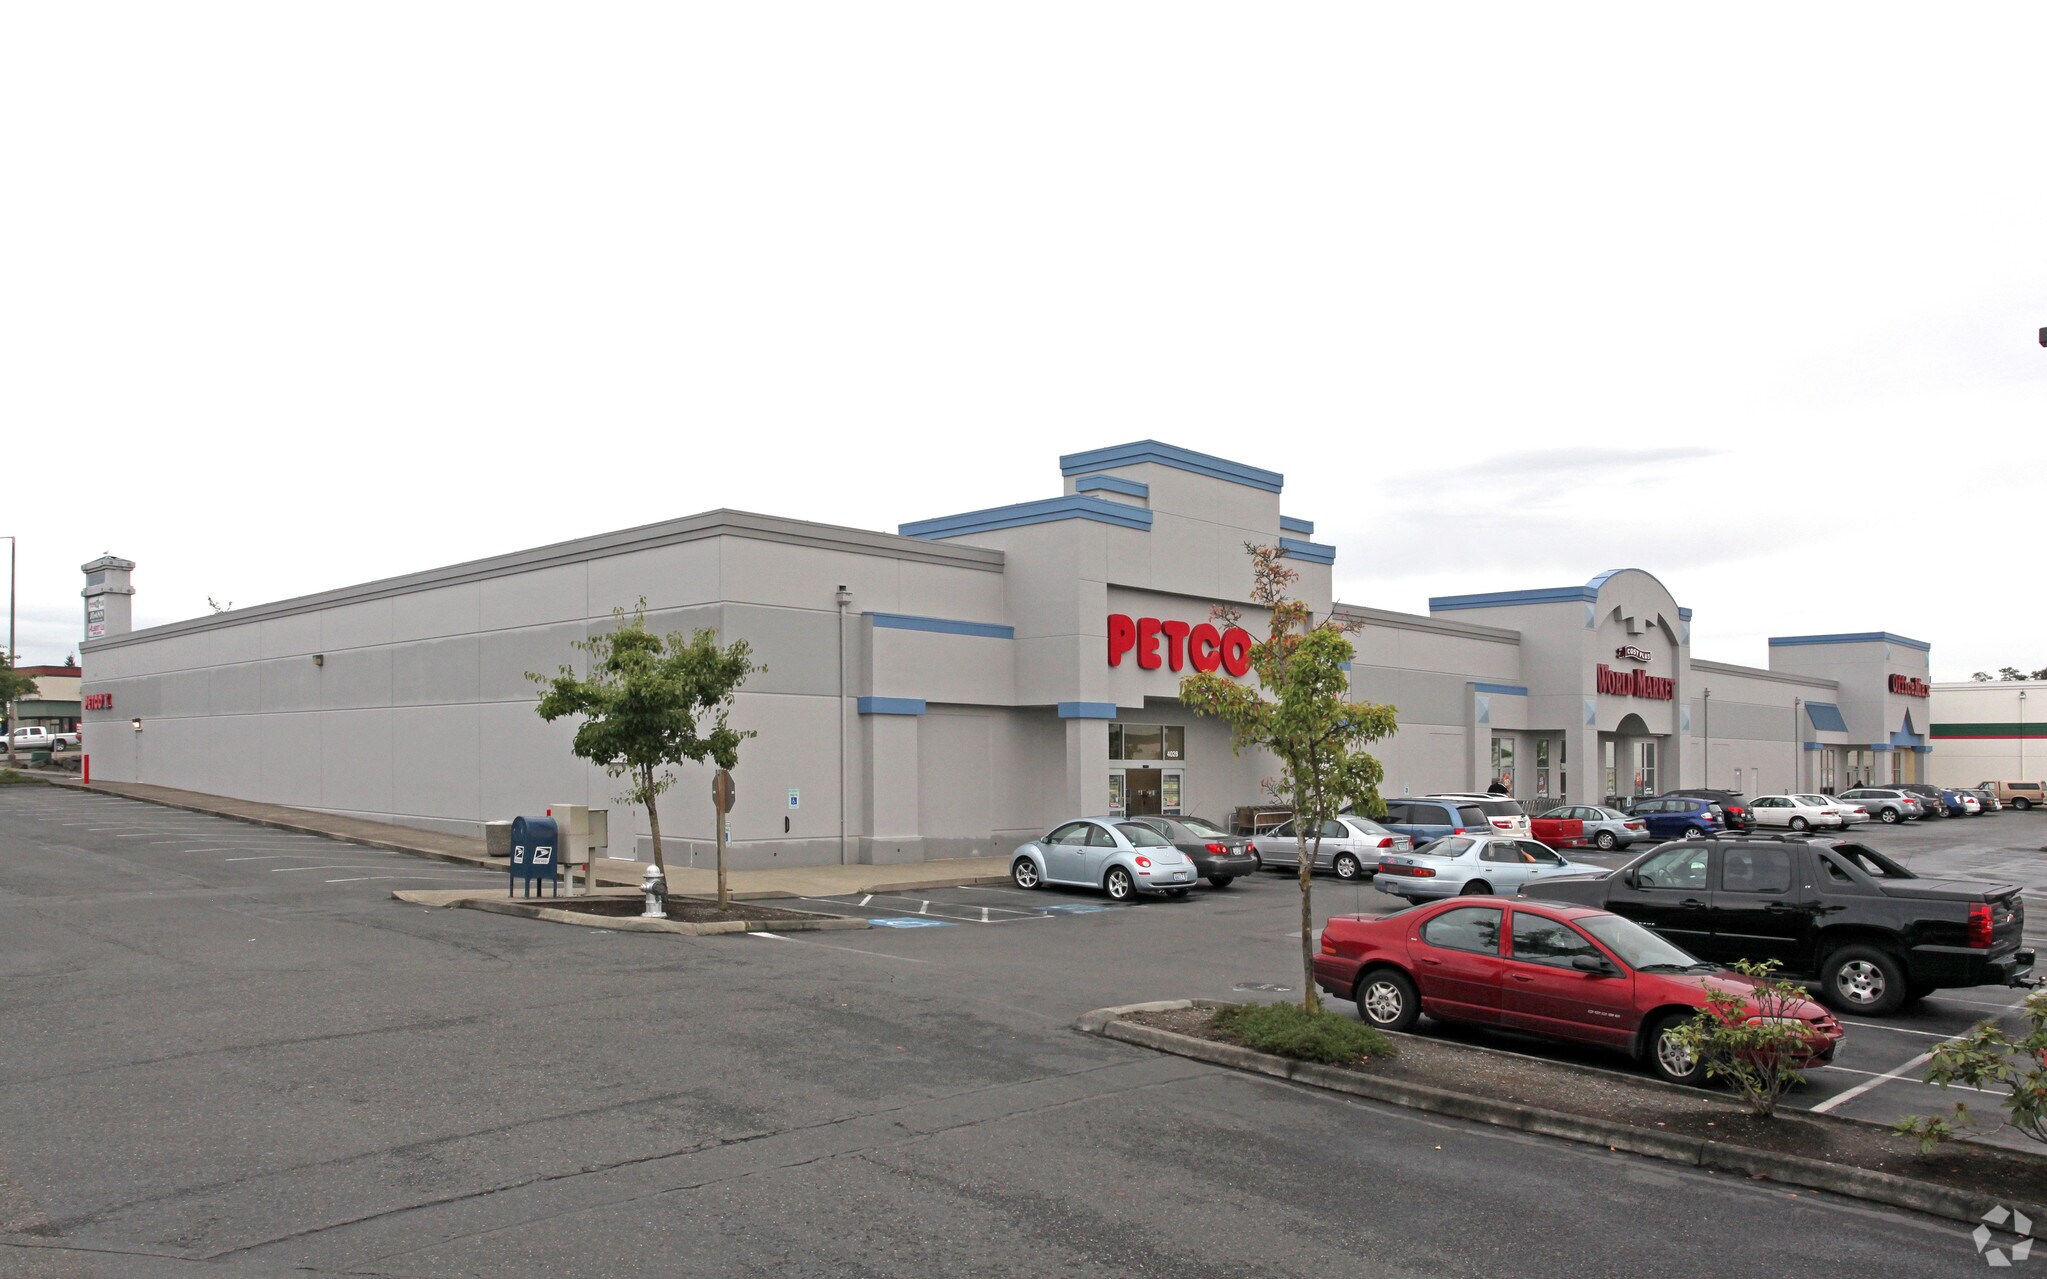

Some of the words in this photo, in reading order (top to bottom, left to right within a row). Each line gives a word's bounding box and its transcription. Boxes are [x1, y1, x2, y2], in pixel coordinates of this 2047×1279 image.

[1107, 613, 1252, 677] PETCO
[1627, 648, 1640, 658] COST
[1639, 652, 1651, 660] PLUS
[1587, 1009, 1621, 1018] DODGE
